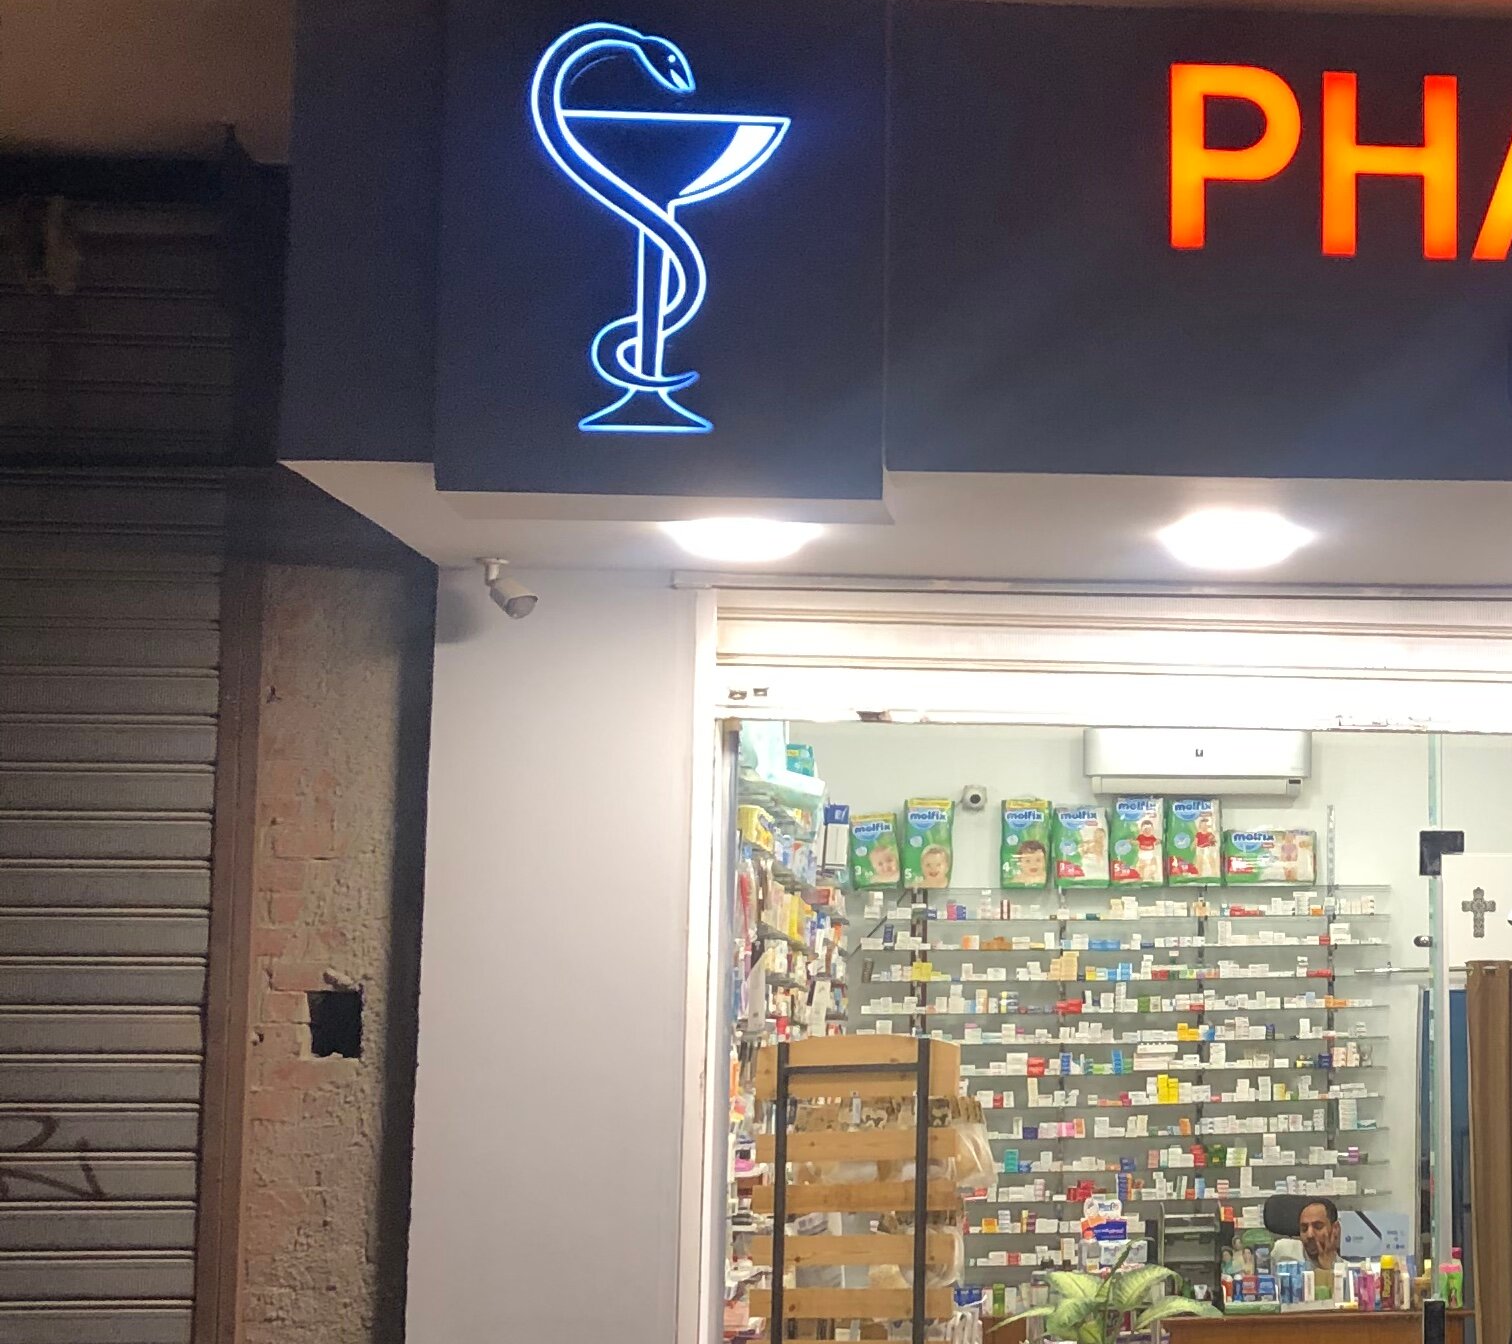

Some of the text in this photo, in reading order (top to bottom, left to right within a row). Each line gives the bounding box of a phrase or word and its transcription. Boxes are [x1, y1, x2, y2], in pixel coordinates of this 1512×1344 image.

[910, 810, 946, 820] molfix
[1006, 810, 1042, 820] molfix
[1060, 810, 1097, 820] molfix
[855, 822, 890, 834] molfix
